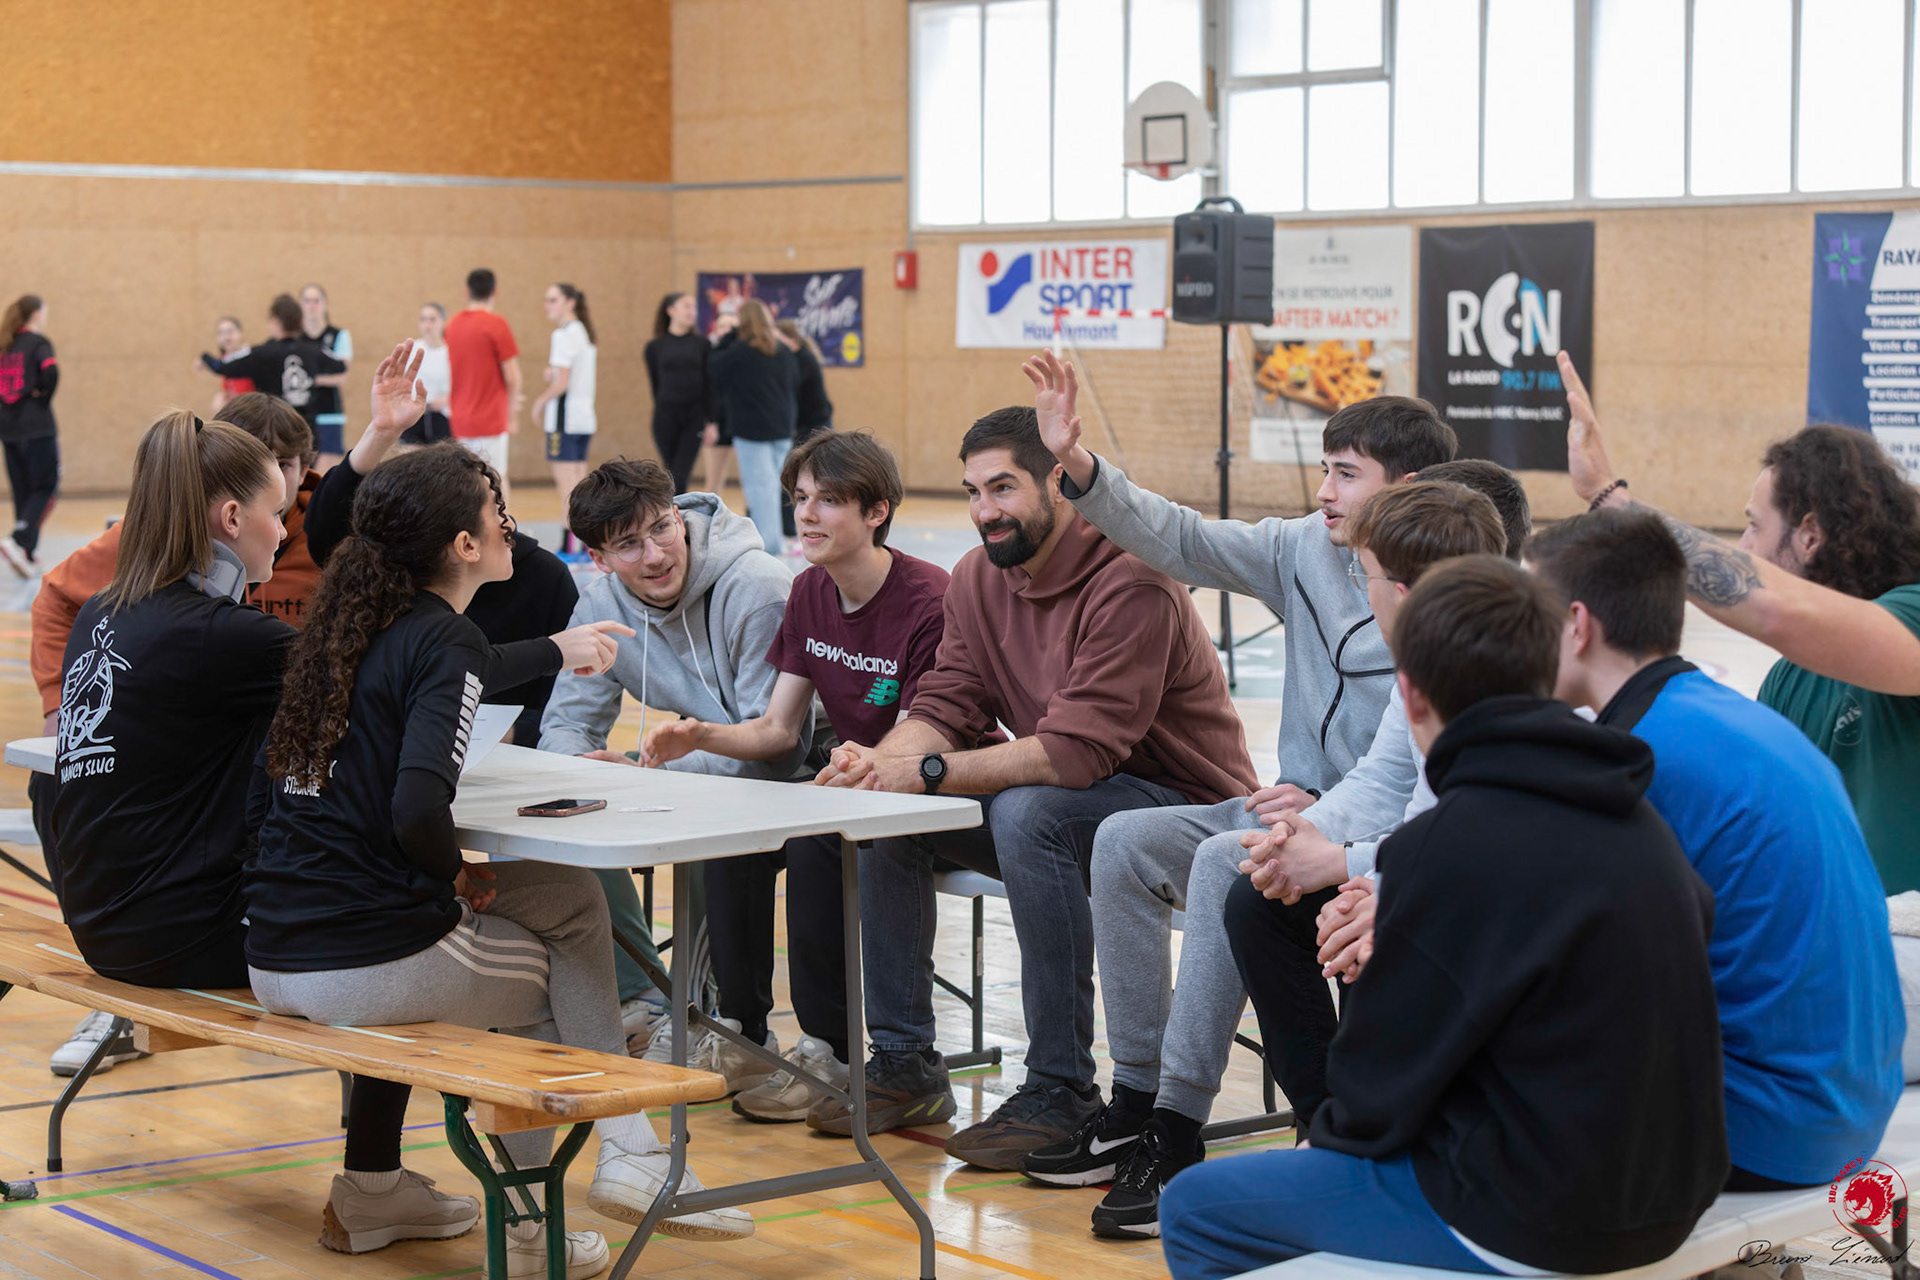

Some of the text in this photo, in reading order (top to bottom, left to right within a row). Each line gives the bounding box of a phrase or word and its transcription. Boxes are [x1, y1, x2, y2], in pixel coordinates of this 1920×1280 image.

[1040, 247, 1133, 279] INTER
[1039, 284, 1134, 315] SPORT
[1361, 284, 1394, 298] POUR
[1327, 306, 1388, 328] MATCH
[1463, 370, 1501, 385] RADIO
[1869, 364, 1917, 376] Location
[1870, 412, 1917, 424] Location
[806, 637, 898, 676] new balance
[61, 756, 115, 785] NANCY SLUC
